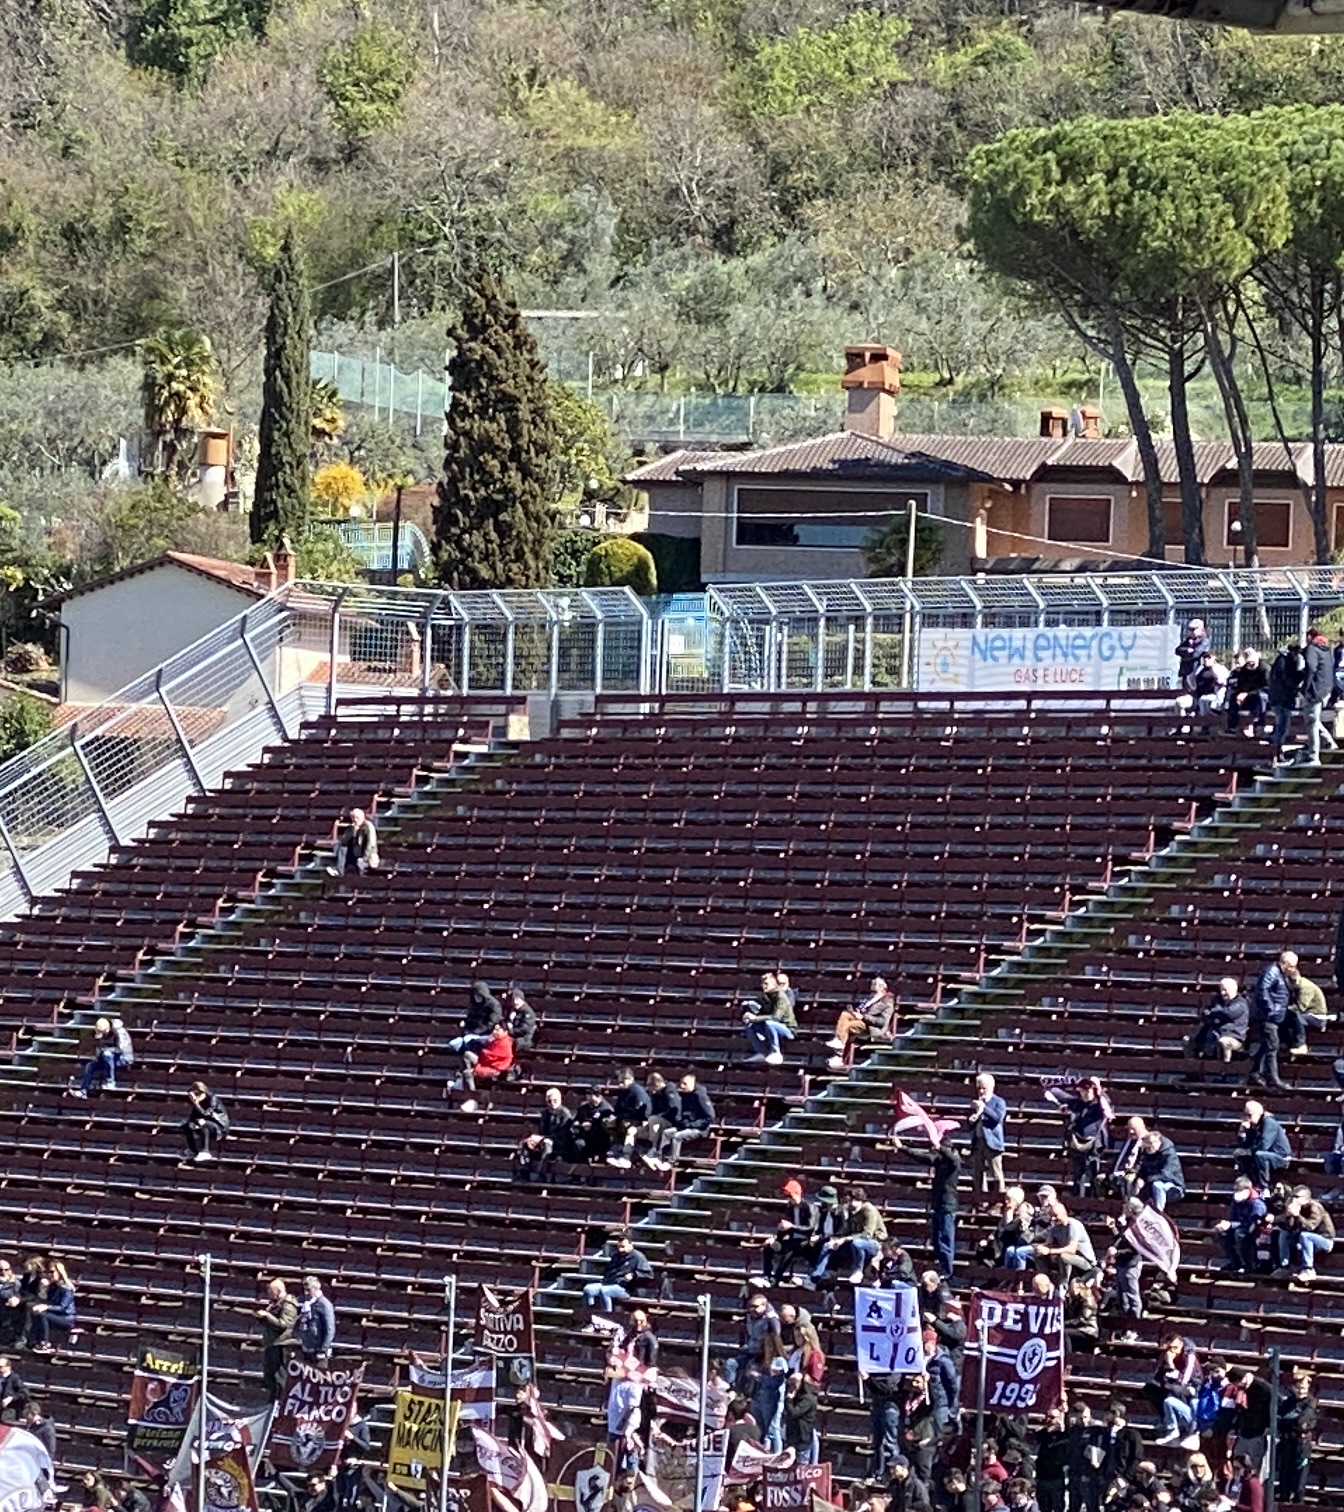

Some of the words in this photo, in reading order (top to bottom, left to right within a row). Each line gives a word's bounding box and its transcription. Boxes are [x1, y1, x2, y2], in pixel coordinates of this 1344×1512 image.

[1013, 667, 1039, 685] GAS
[1042, 668, 1050, 683] E
[1053, 667, 1087, 684] LUCE
[868, 1342, 880, 1363] L
[288, 1381, 314, 1402] AL
[318, 1385, 353, 1404] TUO
